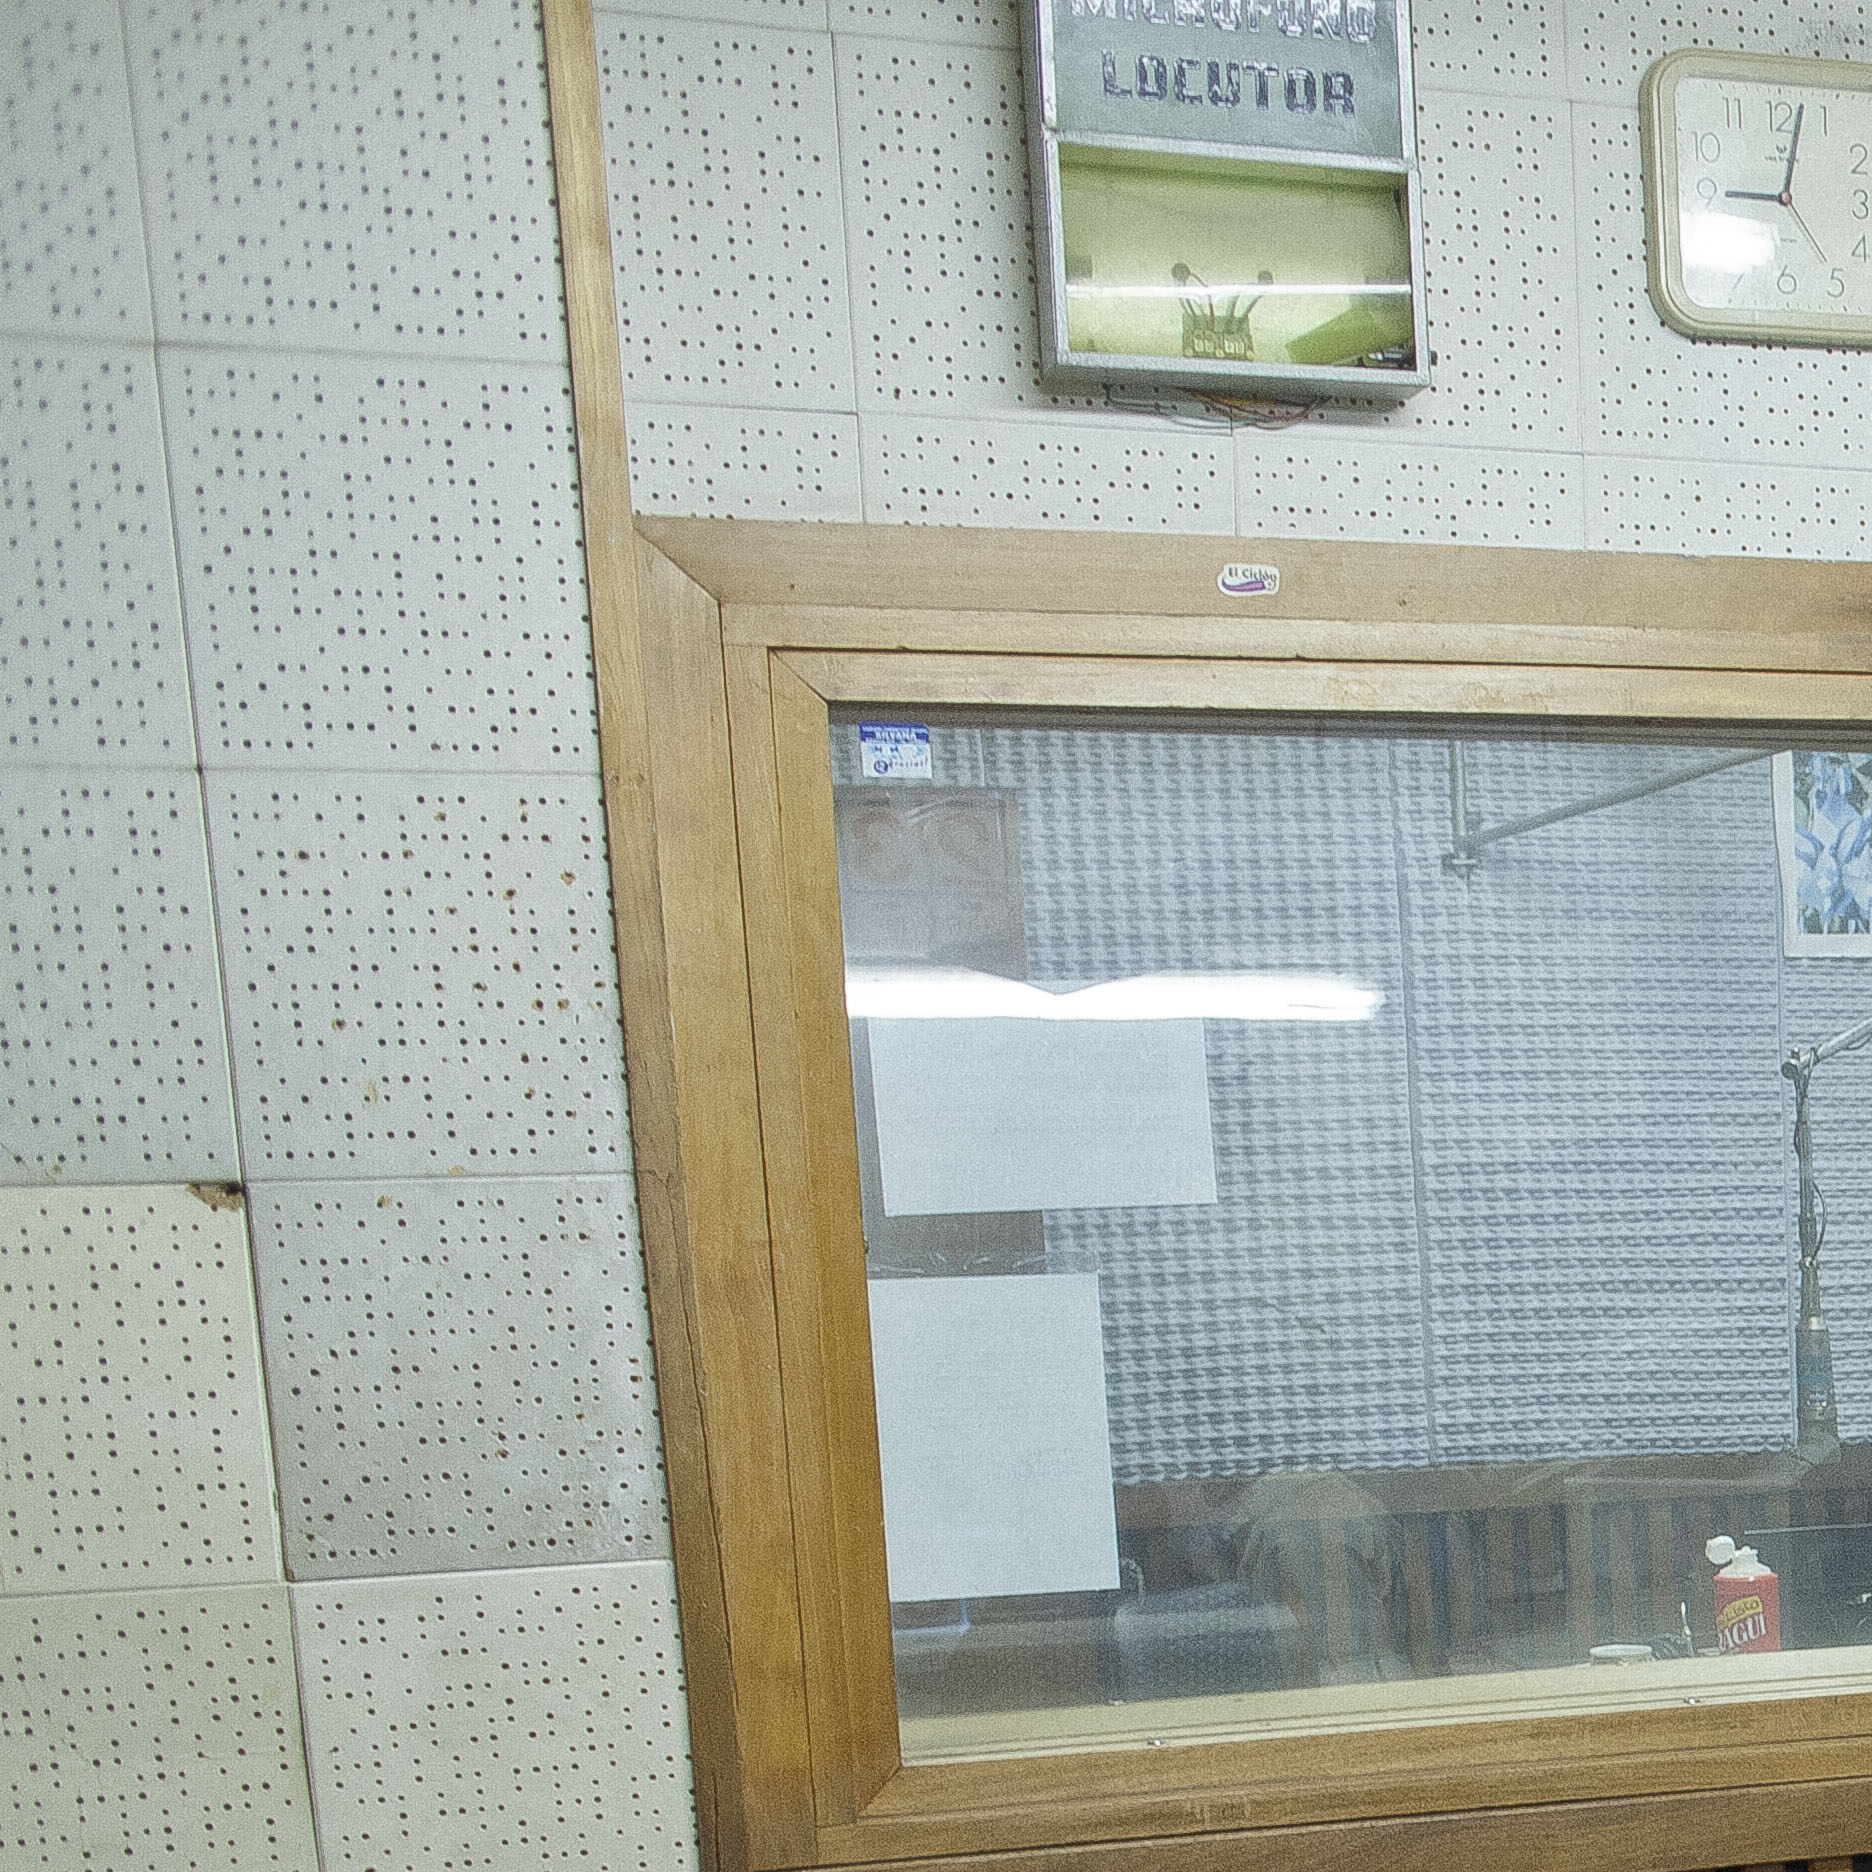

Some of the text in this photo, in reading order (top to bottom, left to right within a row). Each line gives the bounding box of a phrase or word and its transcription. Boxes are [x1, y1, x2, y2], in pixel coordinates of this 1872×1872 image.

[1102, 48, 1355, 118] LOCUTOR
[1722, 97, 1742, 129] 11
[1767, 100, 1794, 134] 12
[1820, 104, 1828, 136] 1
[1692, 130, 1720, 162] 10
[1850, 143, 1868, 176] 2
[1696, 177, 1717, 208] 9
[1852, 188, 1869, 220] 3
[1852, 234, 1870, 263] 4
[1776, 265, 1796, 294] 6
[1826, 268, 1844, 298] 5
